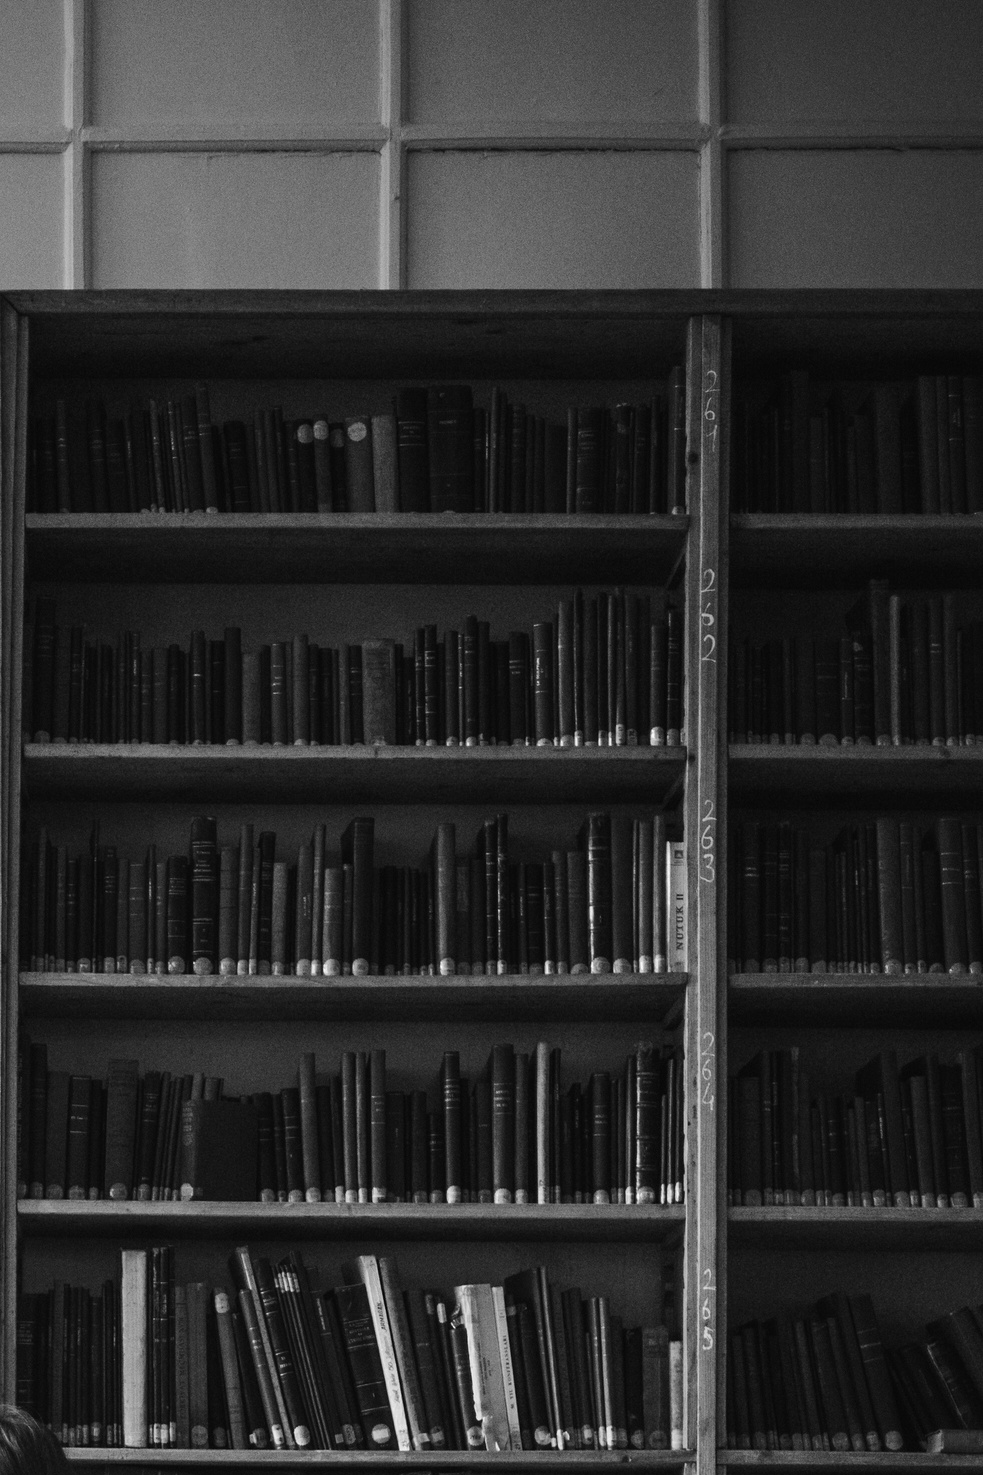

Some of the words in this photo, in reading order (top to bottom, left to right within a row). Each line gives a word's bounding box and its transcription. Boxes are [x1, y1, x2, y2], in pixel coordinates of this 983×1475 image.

[704, 370, 720, 452] 261
[701, 569, 716, 663] 262
[700, 800, 716, 883] 263
[675, 893, 685, 901] II
[675, 906, 685, 950] NUTUK
[701, 1032, 715, 1111] 264
[702, 1269, 716, 1350] 265
